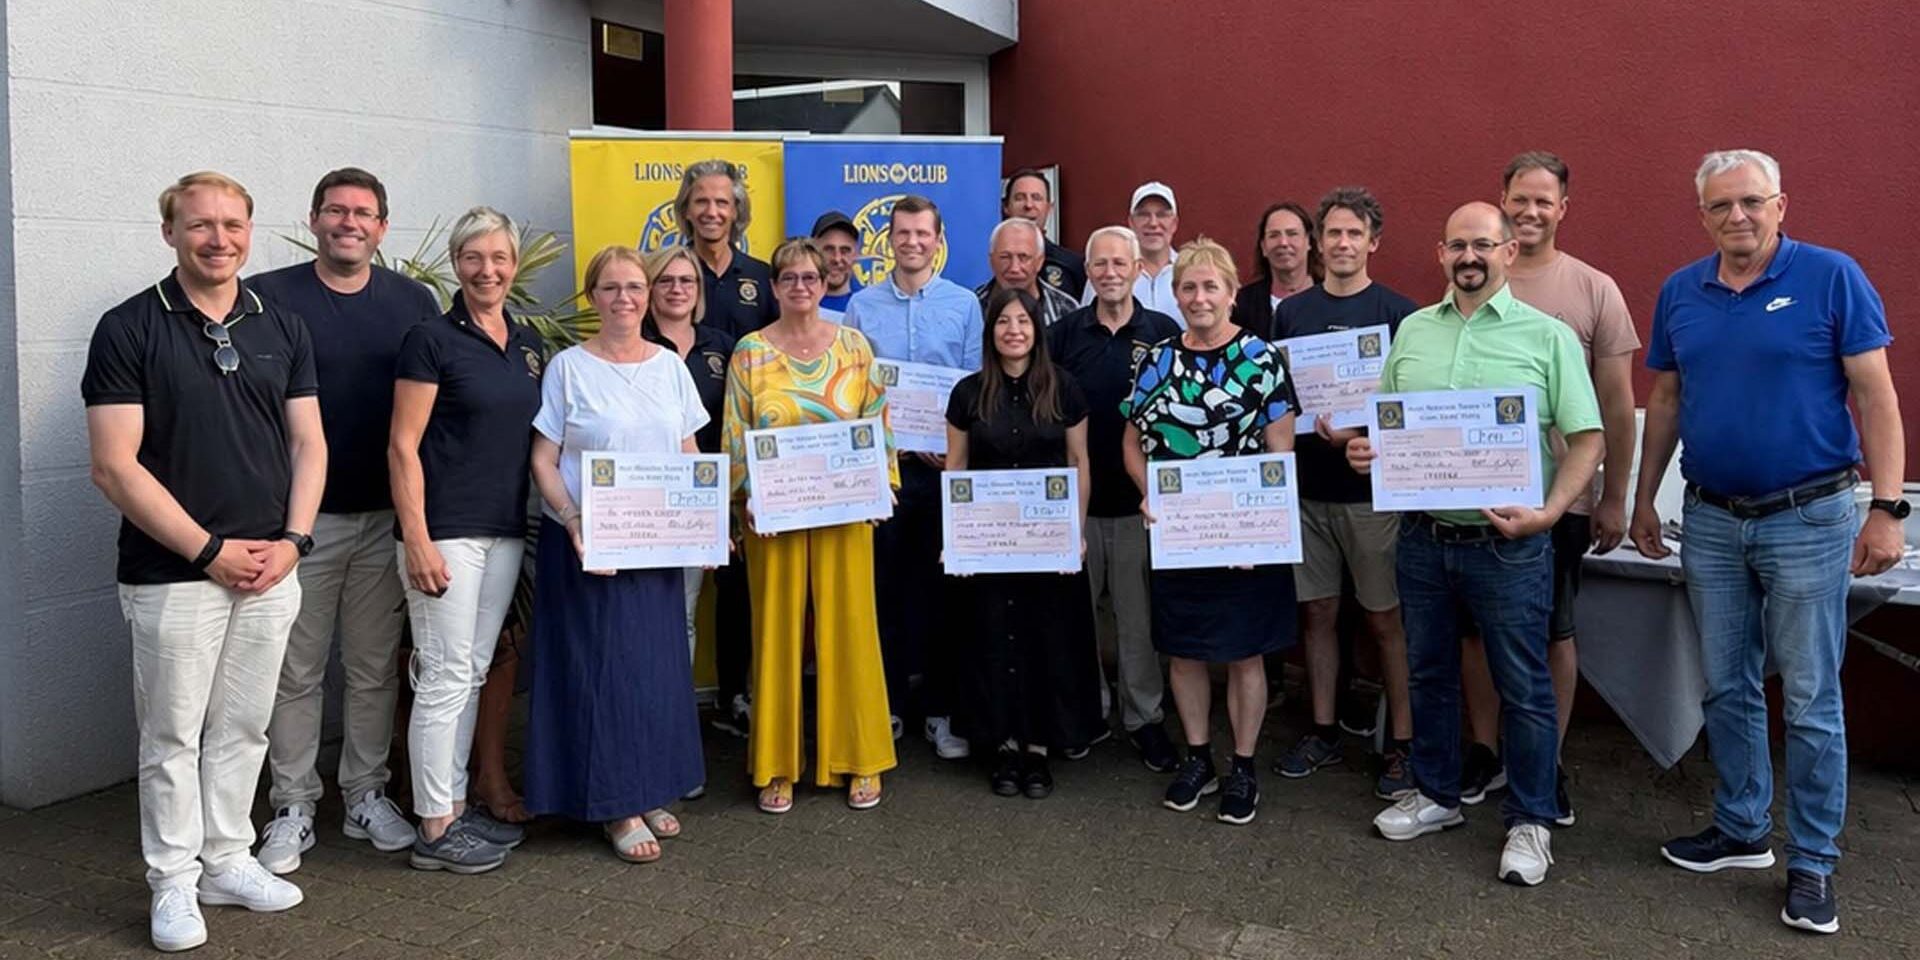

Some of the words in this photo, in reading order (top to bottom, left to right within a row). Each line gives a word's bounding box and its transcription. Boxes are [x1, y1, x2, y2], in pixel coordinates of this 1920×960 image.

[634, 162, 683, 181] LIONS
[844, 164, 889, 183] LIONS
[908, 164, 948, 183] CLUB
